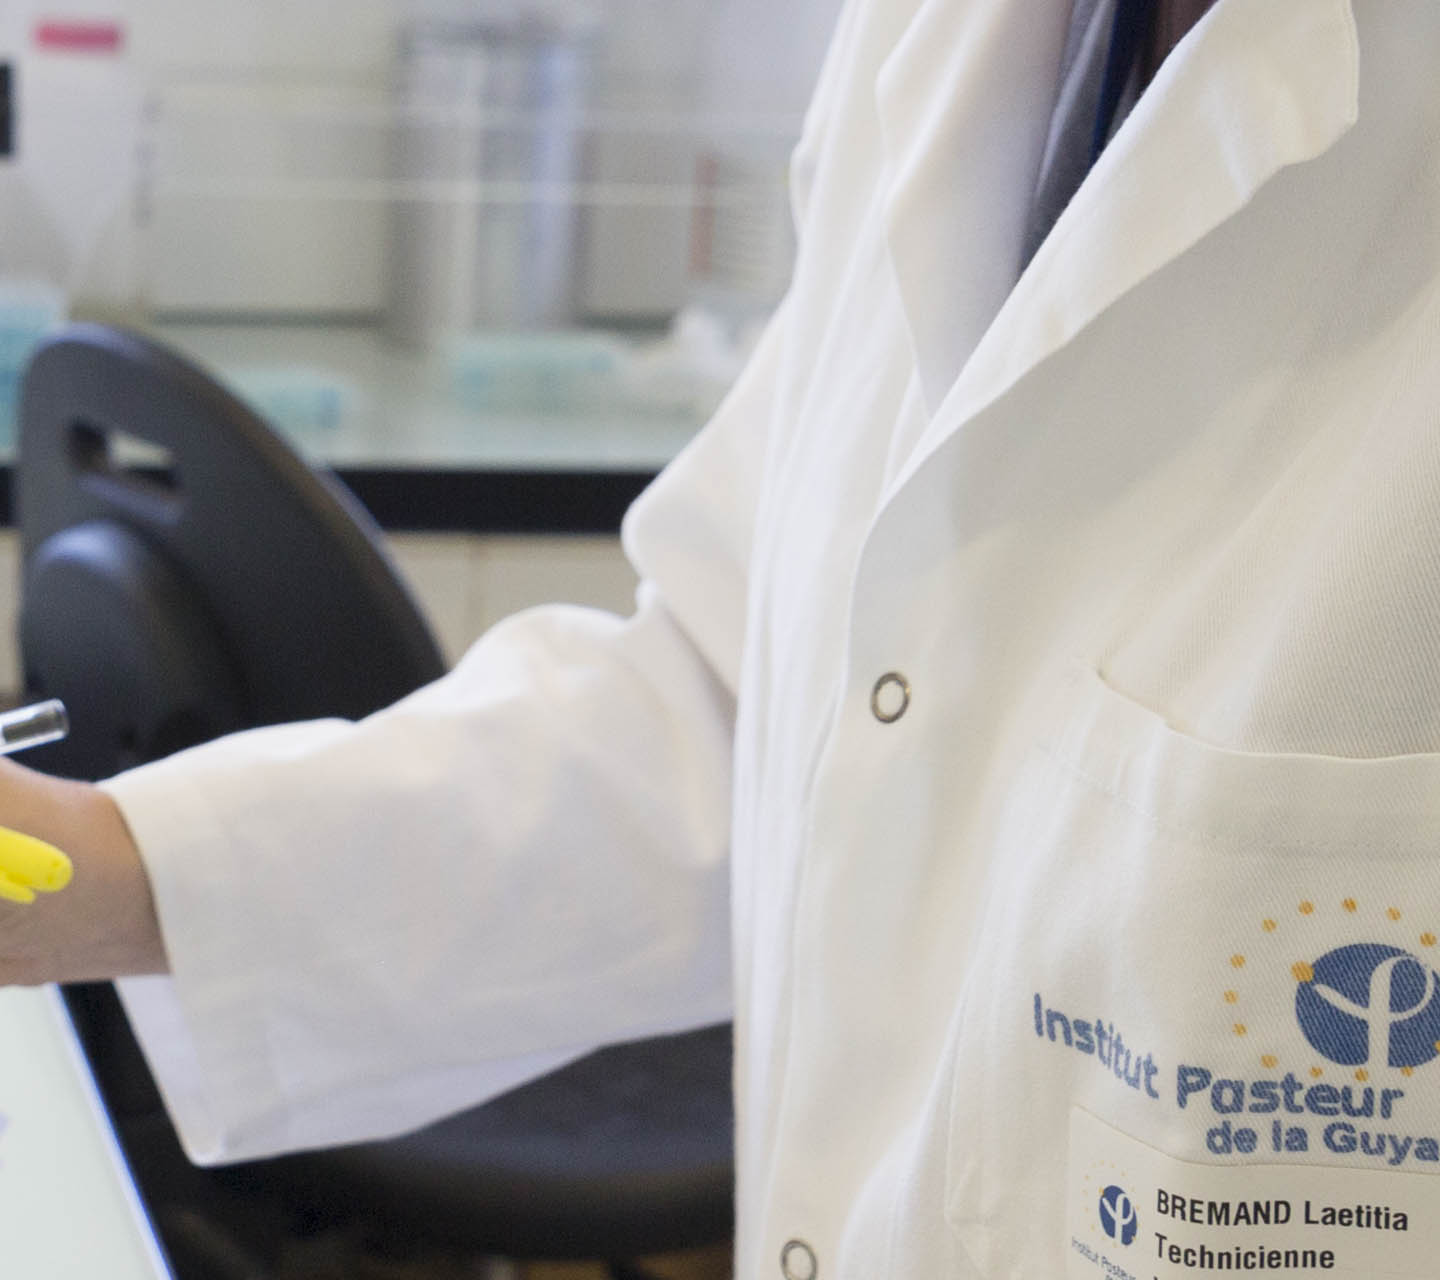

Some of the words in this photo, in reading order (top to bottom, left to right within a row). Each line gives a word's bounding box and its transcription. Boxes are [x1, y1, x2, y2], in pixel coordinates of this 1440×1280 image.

[1033, 991, 1160, 1100] Institut
[1176, 1063, 1405, 1120] Pasteur
[1205, 1120, 1258, 1155] de
[1272, 1119, 1310, 1154] la
[1156, 1188, 1292, 1226] BREMAND
[1303, 1200, 1410, 1232] Laetitia
[1154, 1232, 1336, 1271] Technicienne
